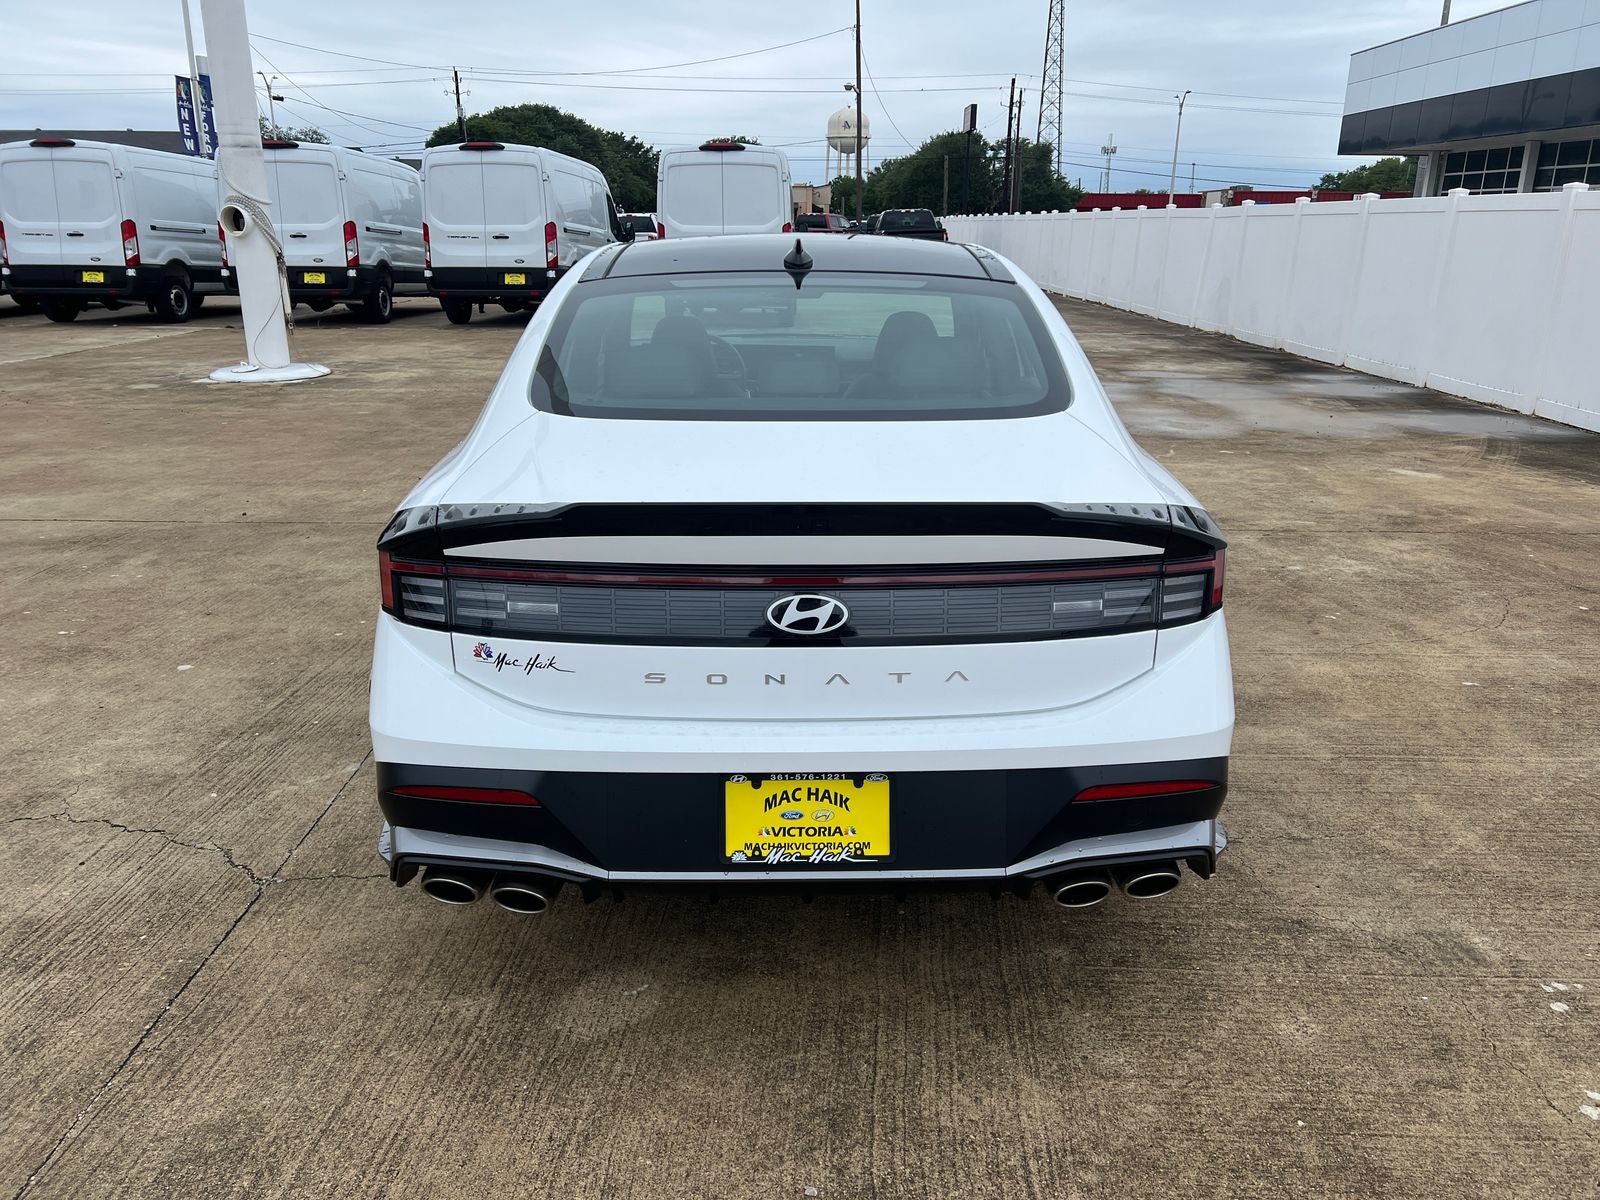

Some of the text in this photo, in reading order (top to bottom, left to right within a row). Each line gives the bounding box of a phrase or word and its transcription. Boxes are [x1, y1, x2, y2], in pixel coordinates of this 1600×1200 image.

[180, 107, 194, 151] NEW
[201, 111, 213, 153] FORD
[494, 651, 567, 676] Mac Haik
[644, 670, 970, 686] SONATA
[770, 773, 846, 781] 361-576-1221
[763, 787, 850, 813] MAC HAIK
[781, 811, 803, 820] Ford
[770, 826, 844, 837] VICTORIA
[764, 846, 860, 865] Mac Haik
